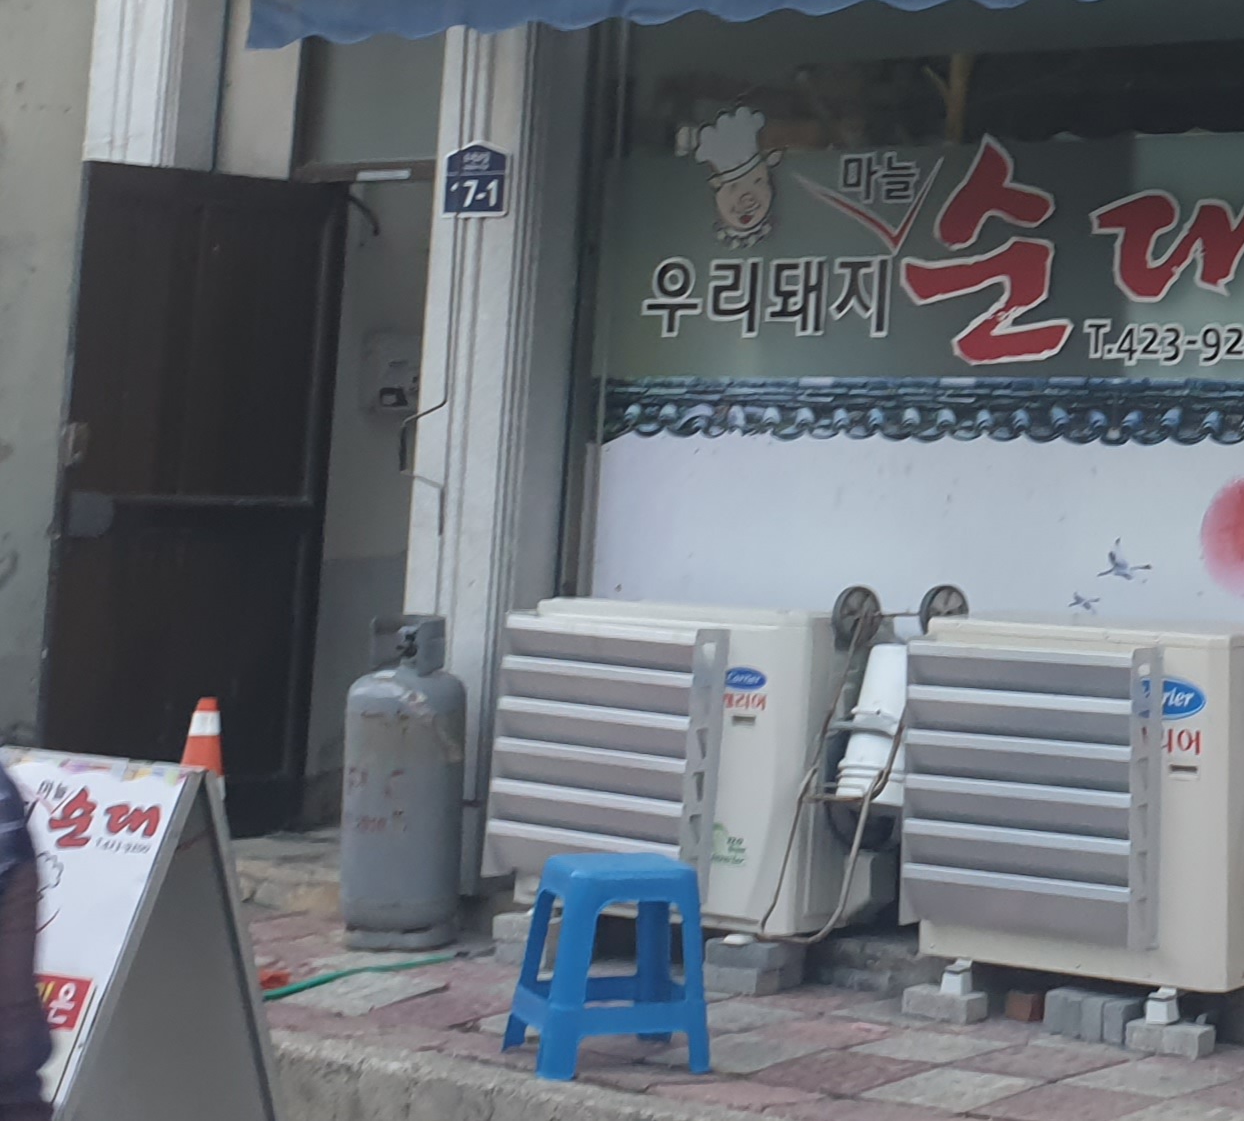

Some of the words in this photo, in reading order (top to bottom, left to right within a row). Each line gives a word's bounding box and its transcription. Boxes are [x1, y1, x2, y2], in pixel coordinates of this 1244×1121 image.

[840, 152, 920, 204] 마늘
[643, 254, 891, 338] 우리돼지
[48, 785, 162, 848] 순대
